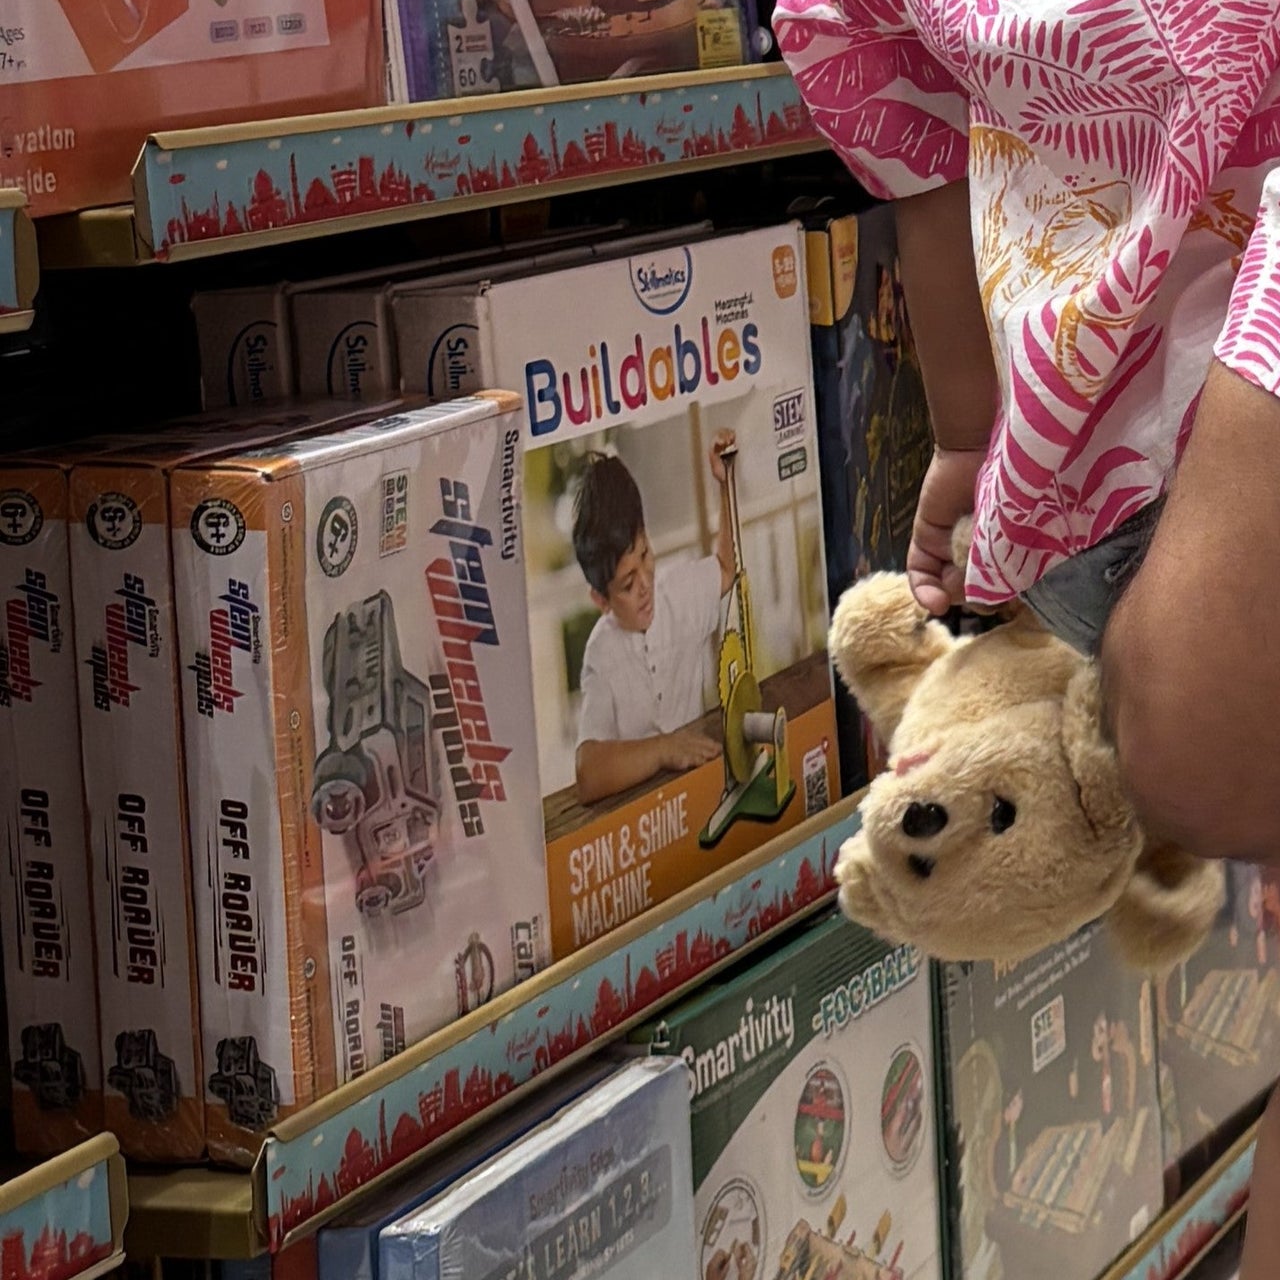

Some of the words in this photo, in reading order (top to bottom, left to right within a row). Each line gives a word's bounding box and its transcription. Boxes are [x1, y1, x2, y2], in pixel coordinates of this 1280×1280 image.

[524, 316, 762, 438] Buildables
[501, 429, 520, 562] Smartivity
[20, 788, 51, 848] OFF
[118, 793, 148, 854] OFF
[220, 799, 250, 860] OFF
[568, 830, 614, 895] SPIN
[619, 825, 637, 868] &
[571, 862, 653, 948] MACHINE
[681, 996, 796, 1102] Smartivity
[543, 1206, 601, 1274] LEARN
